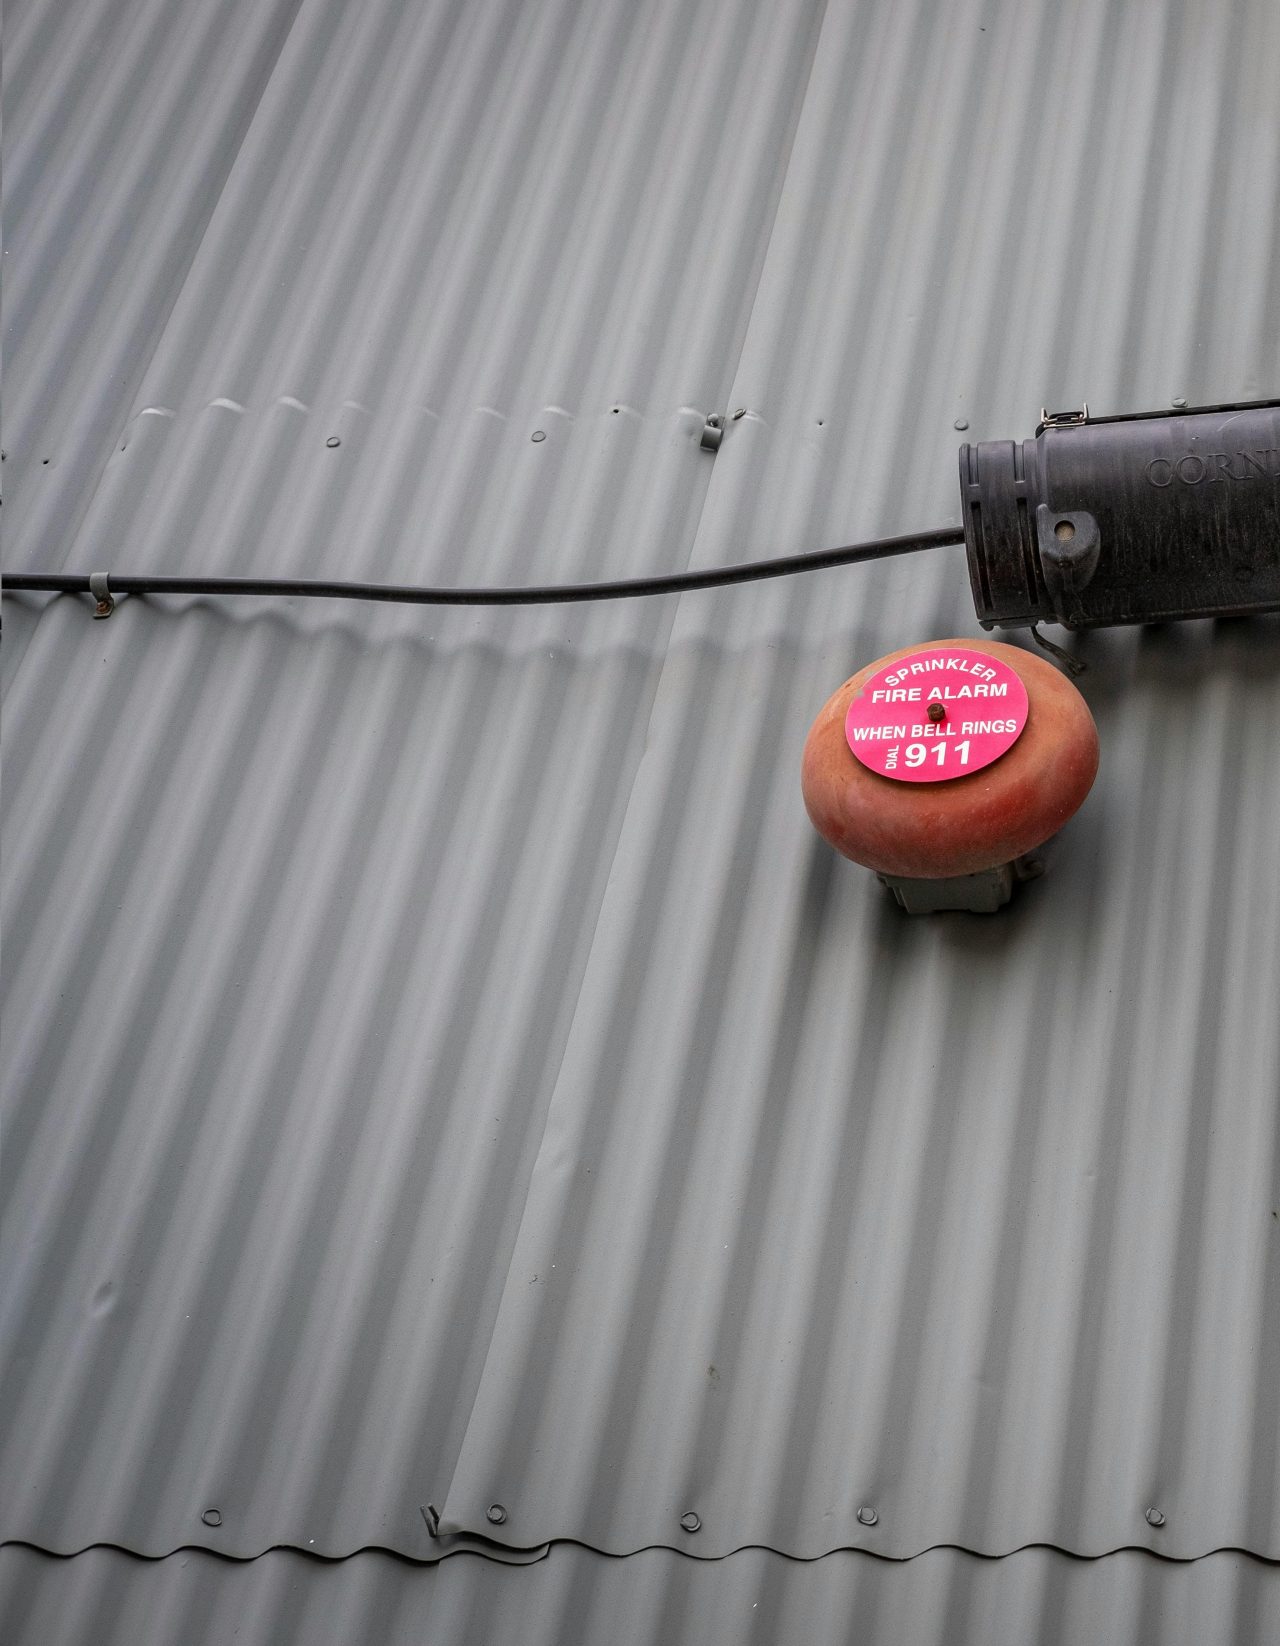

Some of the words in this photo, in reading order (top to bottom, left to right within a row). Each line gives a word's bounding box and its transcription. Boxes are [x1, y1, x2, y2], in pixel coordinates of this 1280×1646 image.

[885, 658, 996, 686] SPRINKLER
[872, 688, 922, 703] FIRE
[927, 683, 1008, 701] ALARM
[853, 725, 906, 741] WHEN
[911, 723, 956, 738] BELL
[961, 719, 1017, 735] RINGS
[885, 744, 900, 770] DIAL
[904, 740, 971, 768] 911
